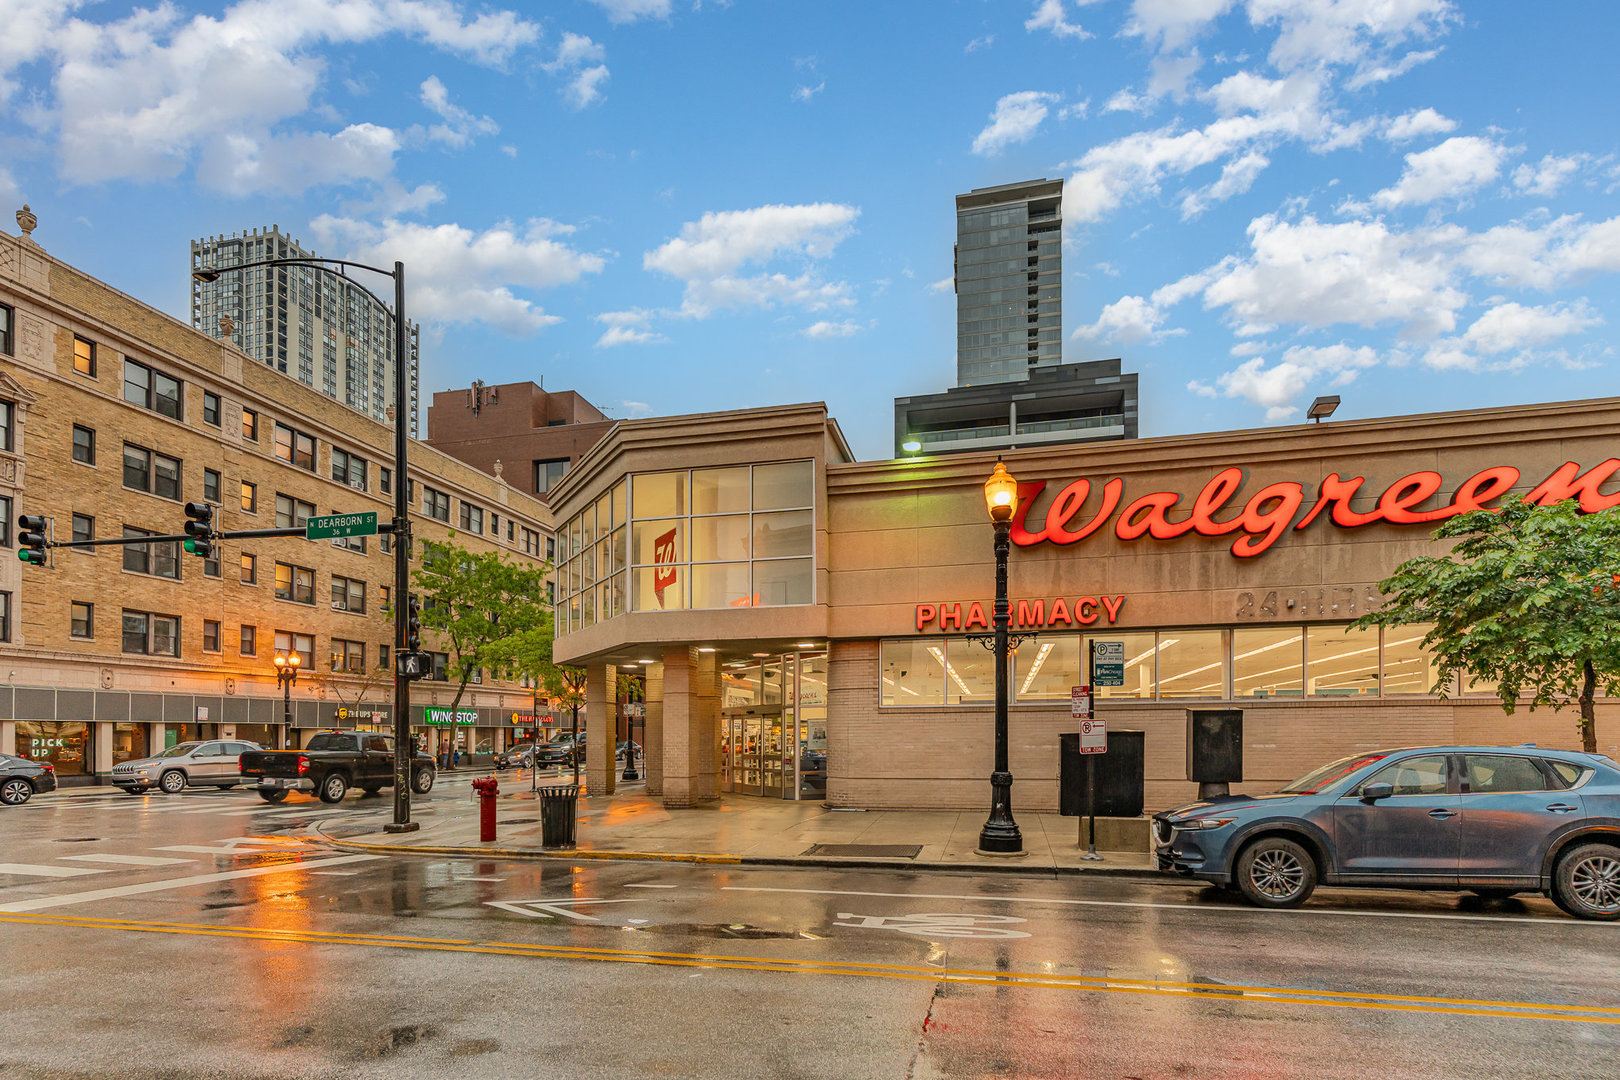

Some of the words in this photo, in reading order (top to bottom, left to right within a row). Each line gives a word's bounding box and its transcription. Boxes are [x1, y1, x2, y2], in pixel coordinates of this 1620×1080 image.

[318, 516, 363, 528] DEARBORN
[366, 515, 374, 523] ST
[332, 528, 340, 536] 36
[916, 596, 1125, 630] PHARMACY
[32, 738, 64, 747] PICK
[32, 749, 48, 757] UP
